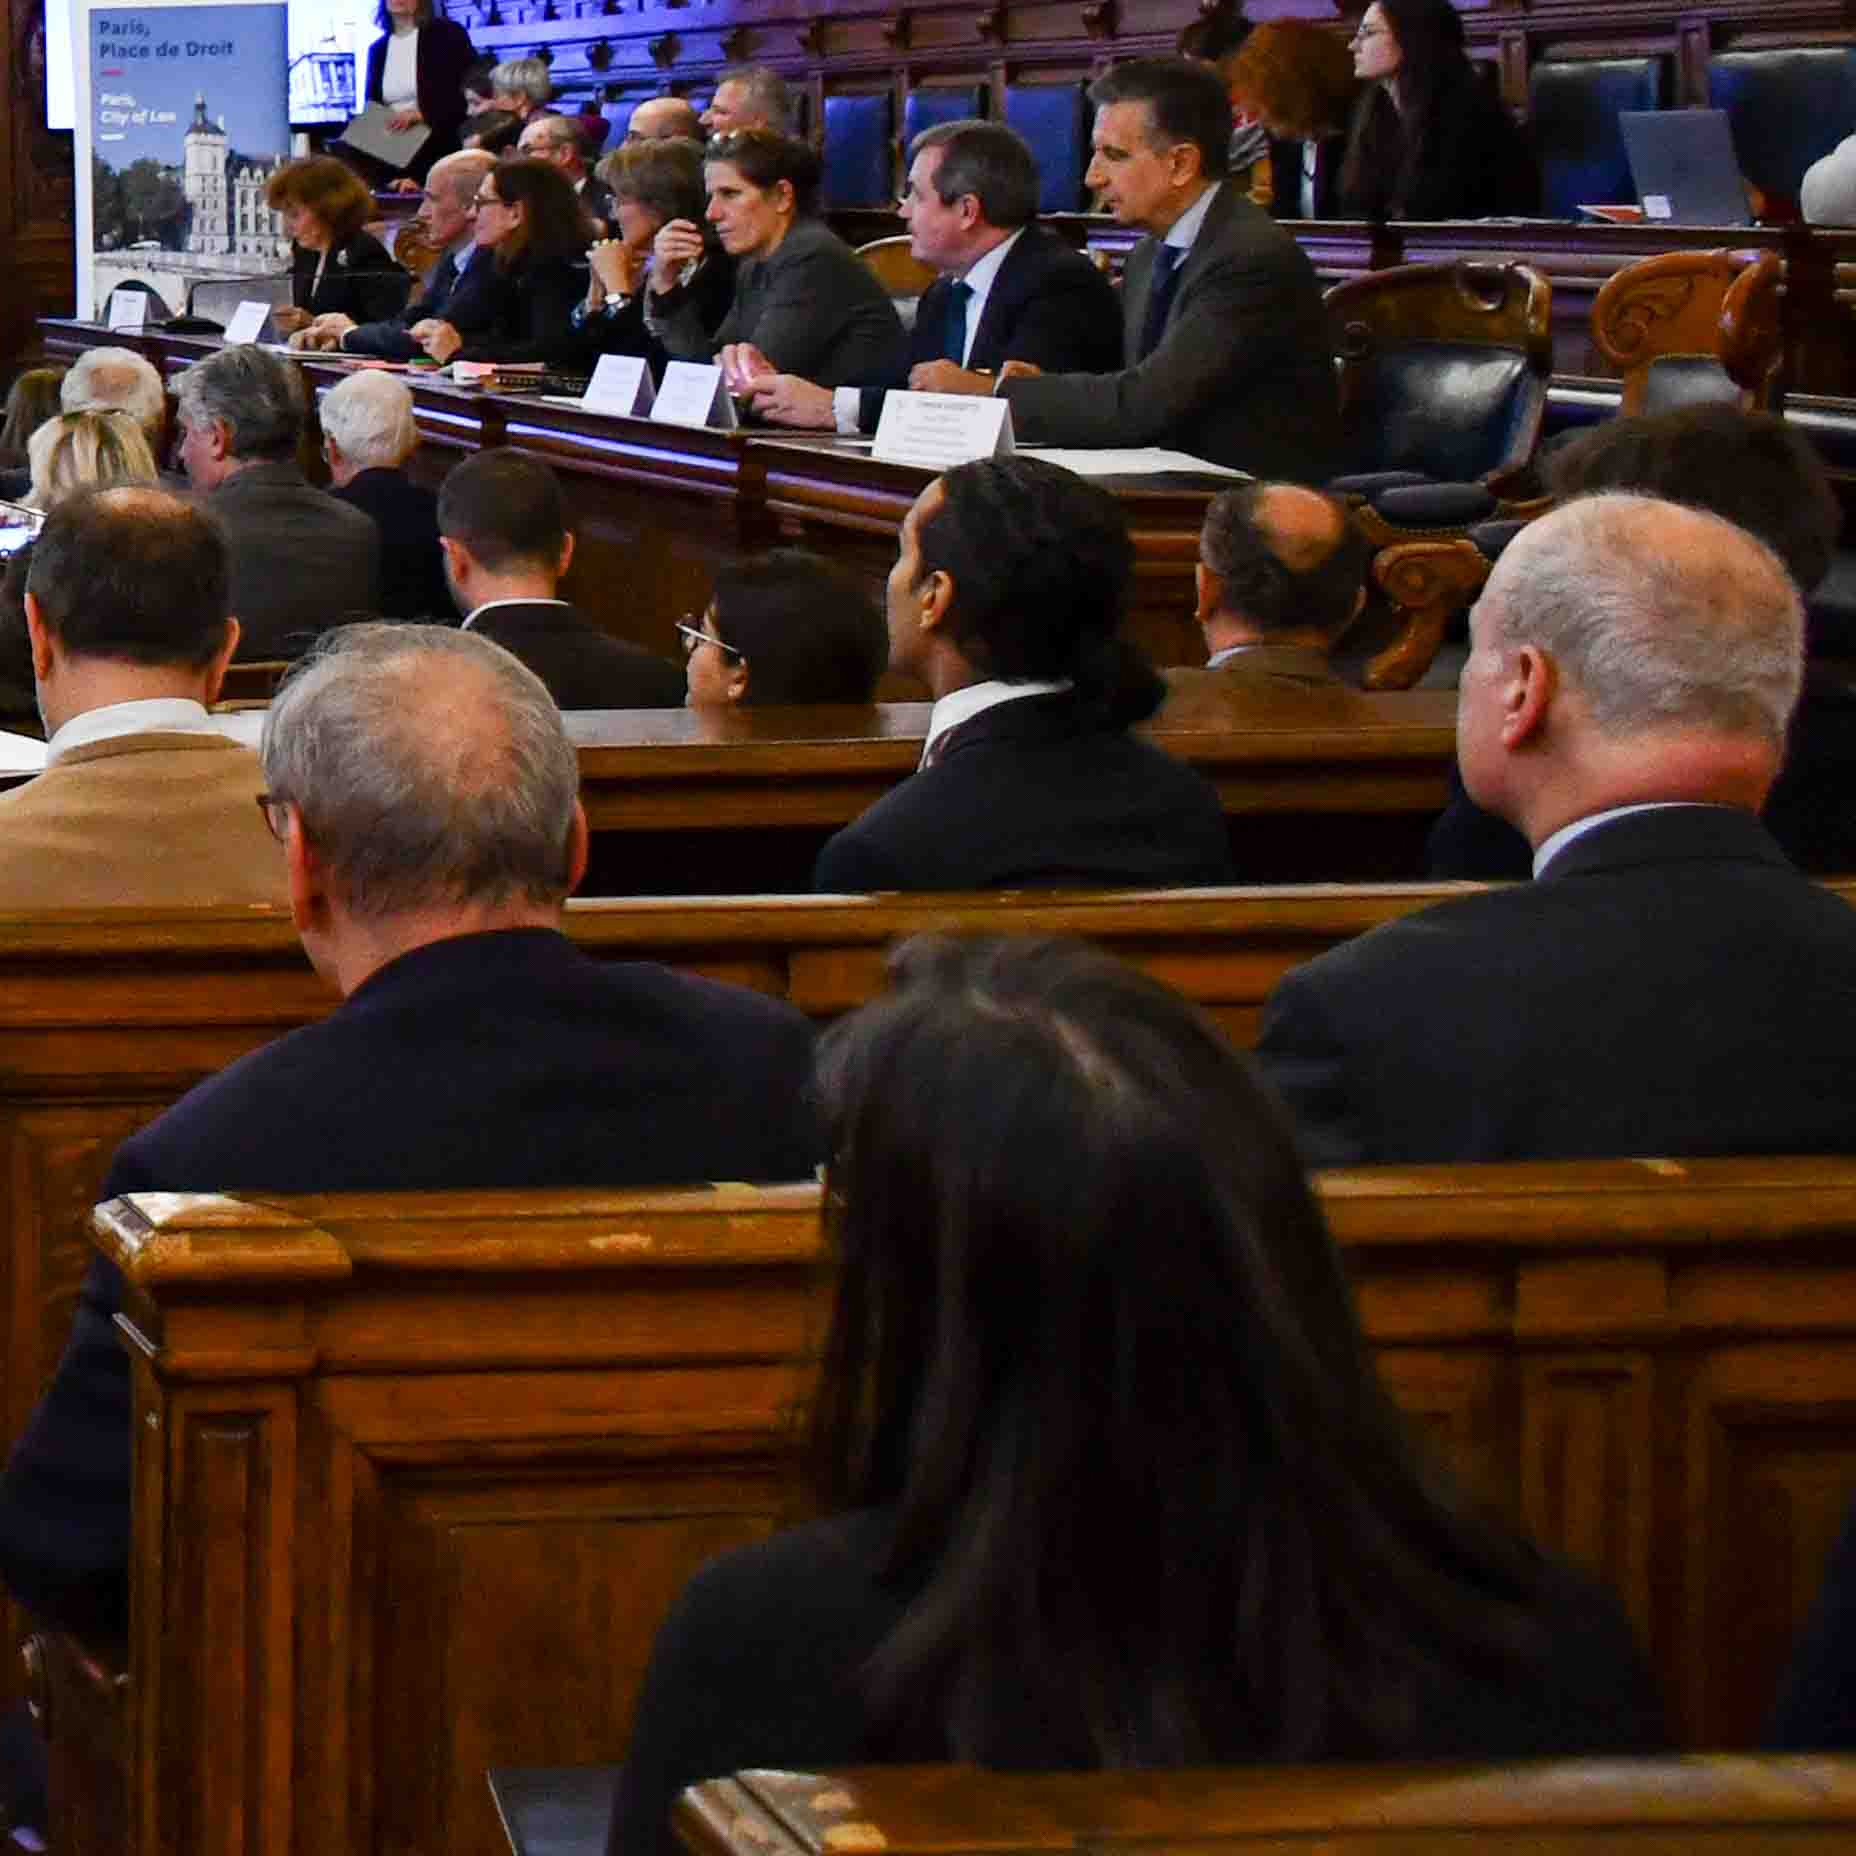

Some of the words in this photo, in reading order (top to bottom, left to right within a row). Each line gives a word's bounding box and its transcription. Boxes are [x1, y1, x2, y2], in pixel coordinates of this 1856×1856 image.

[99, 18, 151, 38] Paris,
[100, 39, 150, 58] Place
[155, 40, 179, 57] de
[185, 39, 234, 57] Droit
